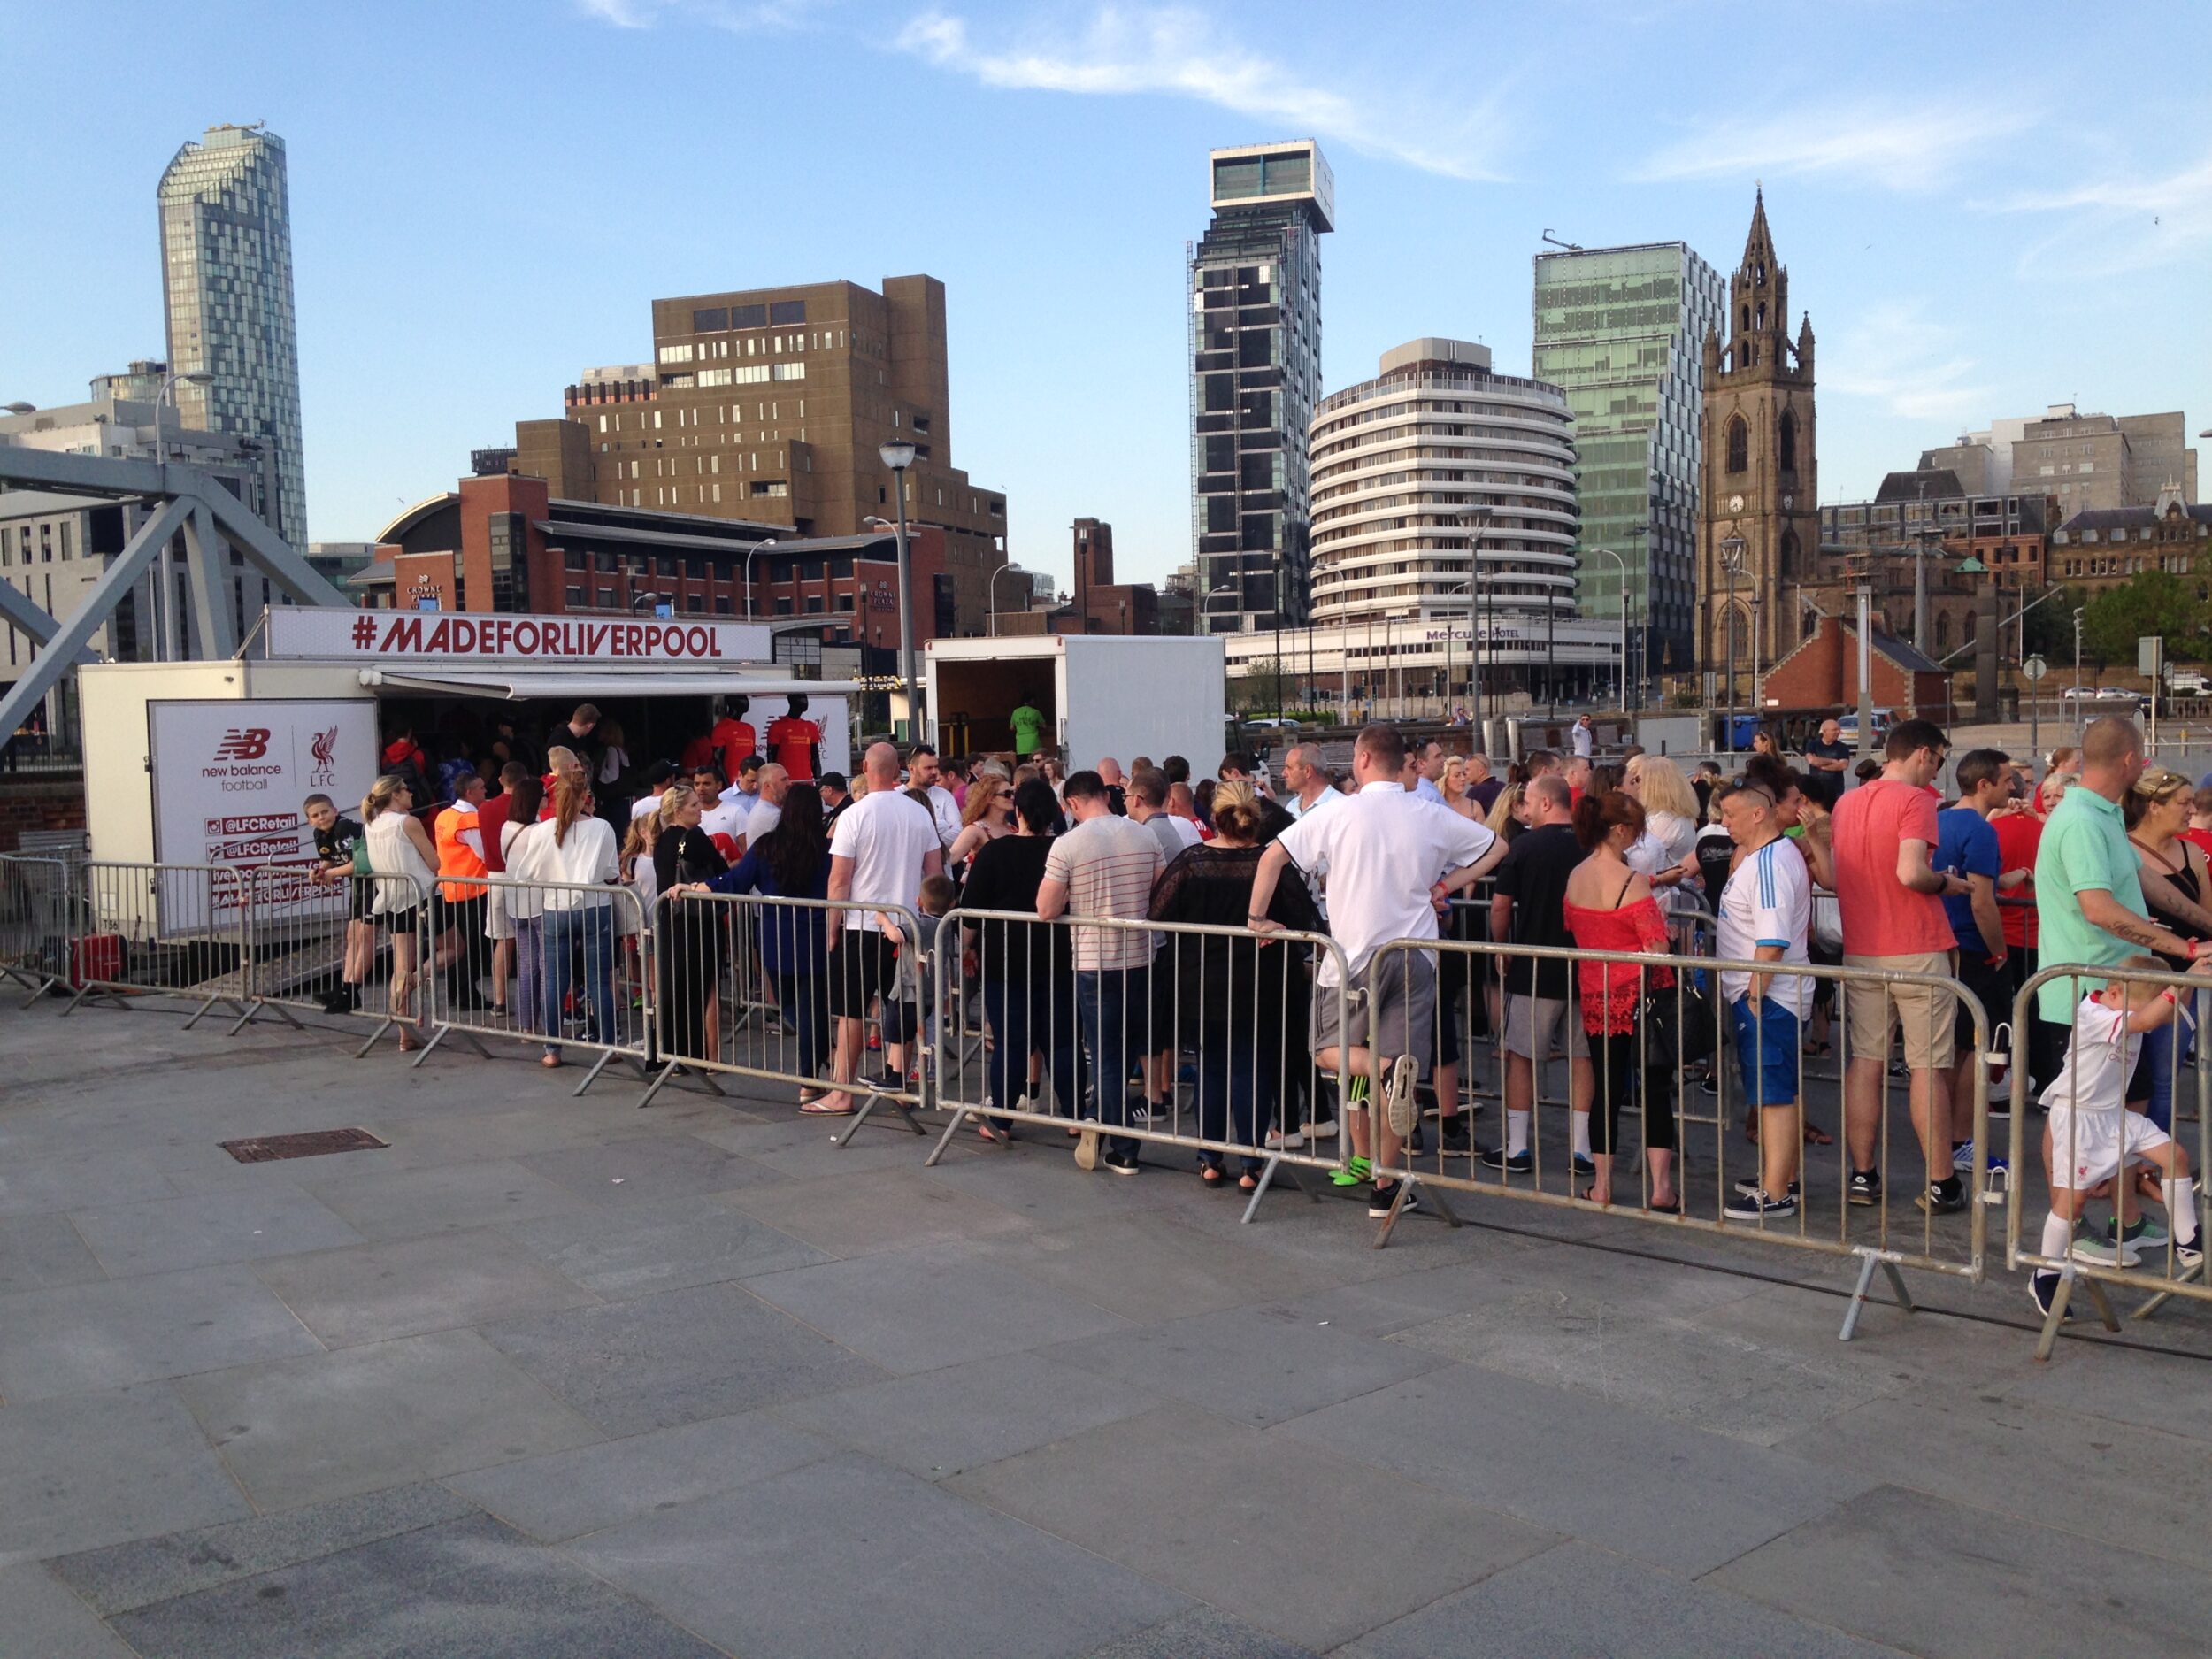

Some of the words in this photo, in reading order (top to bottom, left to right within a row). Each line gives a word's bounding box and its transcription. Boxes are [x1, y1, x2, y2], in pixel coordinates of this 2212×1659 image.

[407, 585, 441, 594] CROWNE
[352, 615, 722, 657] #MADEFORLIVERPOOL
[202, 767, 227, 778] new
[231, 764, 281, 776] balance
[221, 779, 267, 792] football
[226, 816, 296, 833] @LFCRetail
